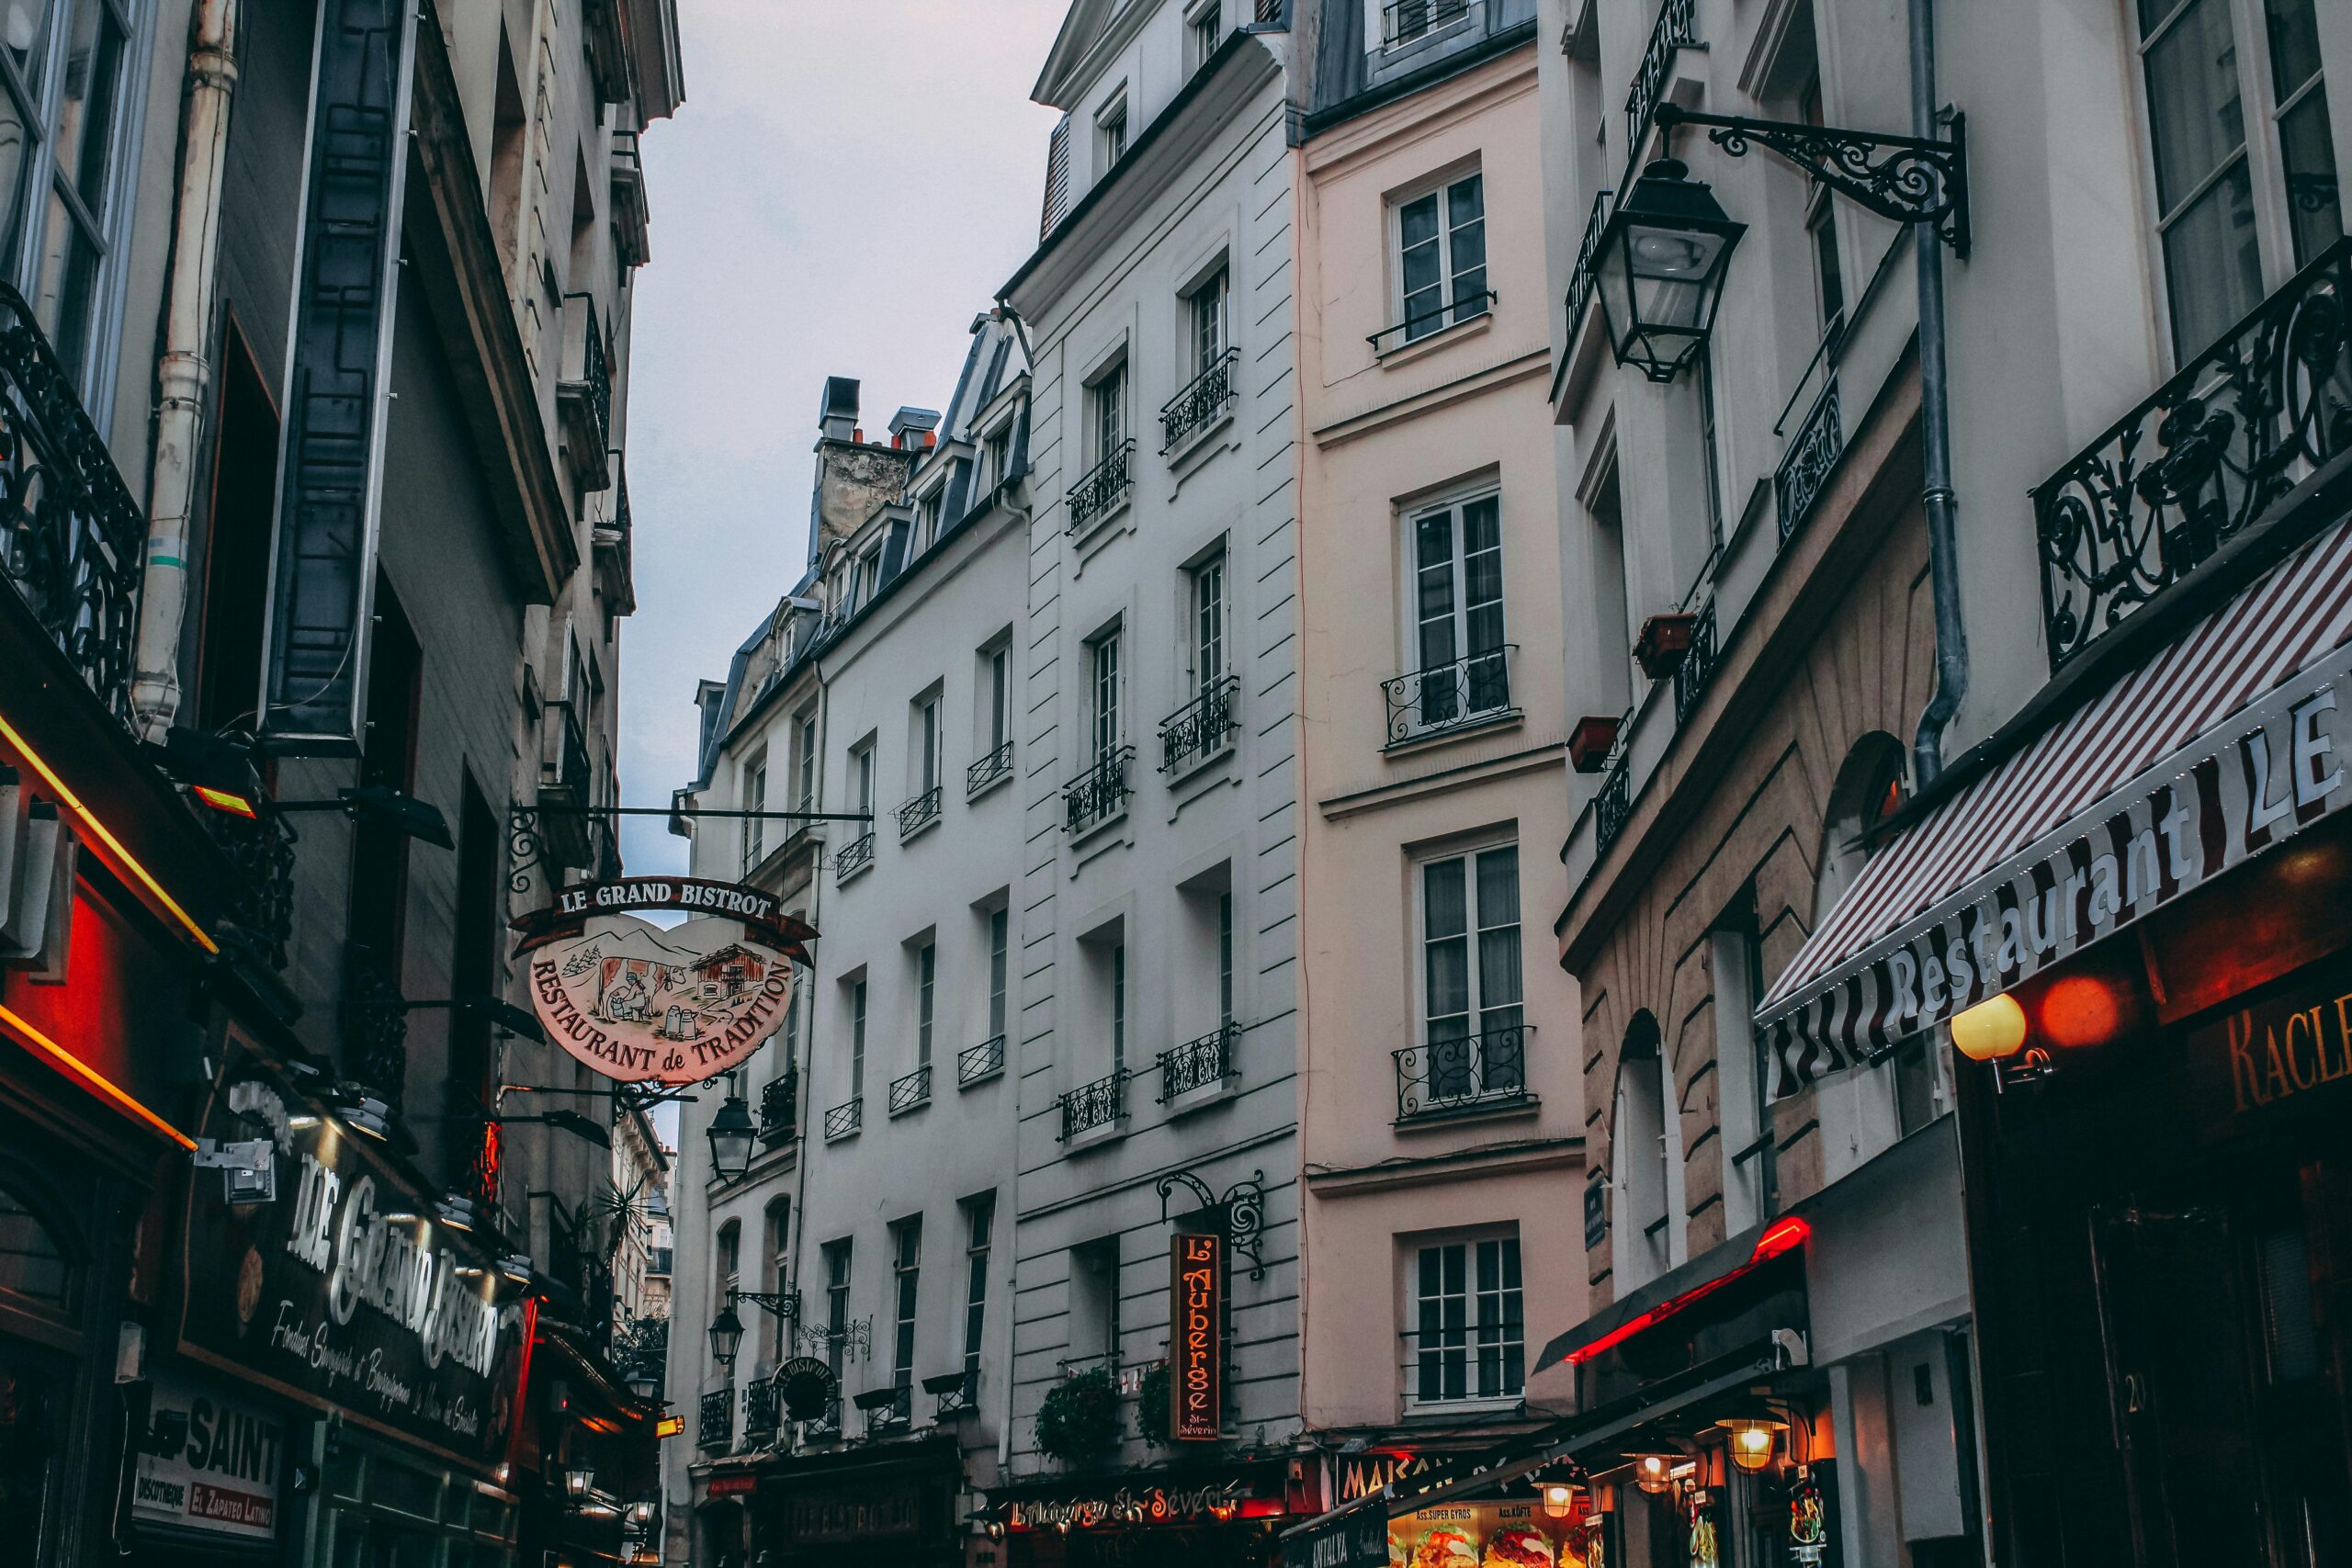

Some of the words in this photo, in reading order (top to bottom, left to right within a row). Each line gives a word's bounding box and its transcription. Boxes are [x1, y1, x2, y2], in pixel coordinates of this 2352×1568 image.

[1882, 788, 2192, 1031] Restaurant
[2251, 689, 2343, 834] LE
[560, 890, 588, 913] LE
[596, 883, 672, 905] GRAND
[680, 885, 772, 919] BISTROT
[533, 958, 657, 1071] RESTAURANT
[662, 1047, 685, 1071] de
[690, 960, 793, 1067] TRADITION
[286, 1153, 341, 1275] LE
[2125, 1371, 2147, 1413] 20
[187, 1396, 282, 1485] SAINT
[1180, 1424, 1216, 1435] Séverin
[138, 1476, 186, 1509] DISCOTHEQUE
[1451, 1507, 1471, 1519] GYROS
[1312, 1530, 1348, 1568] ANTALYA
